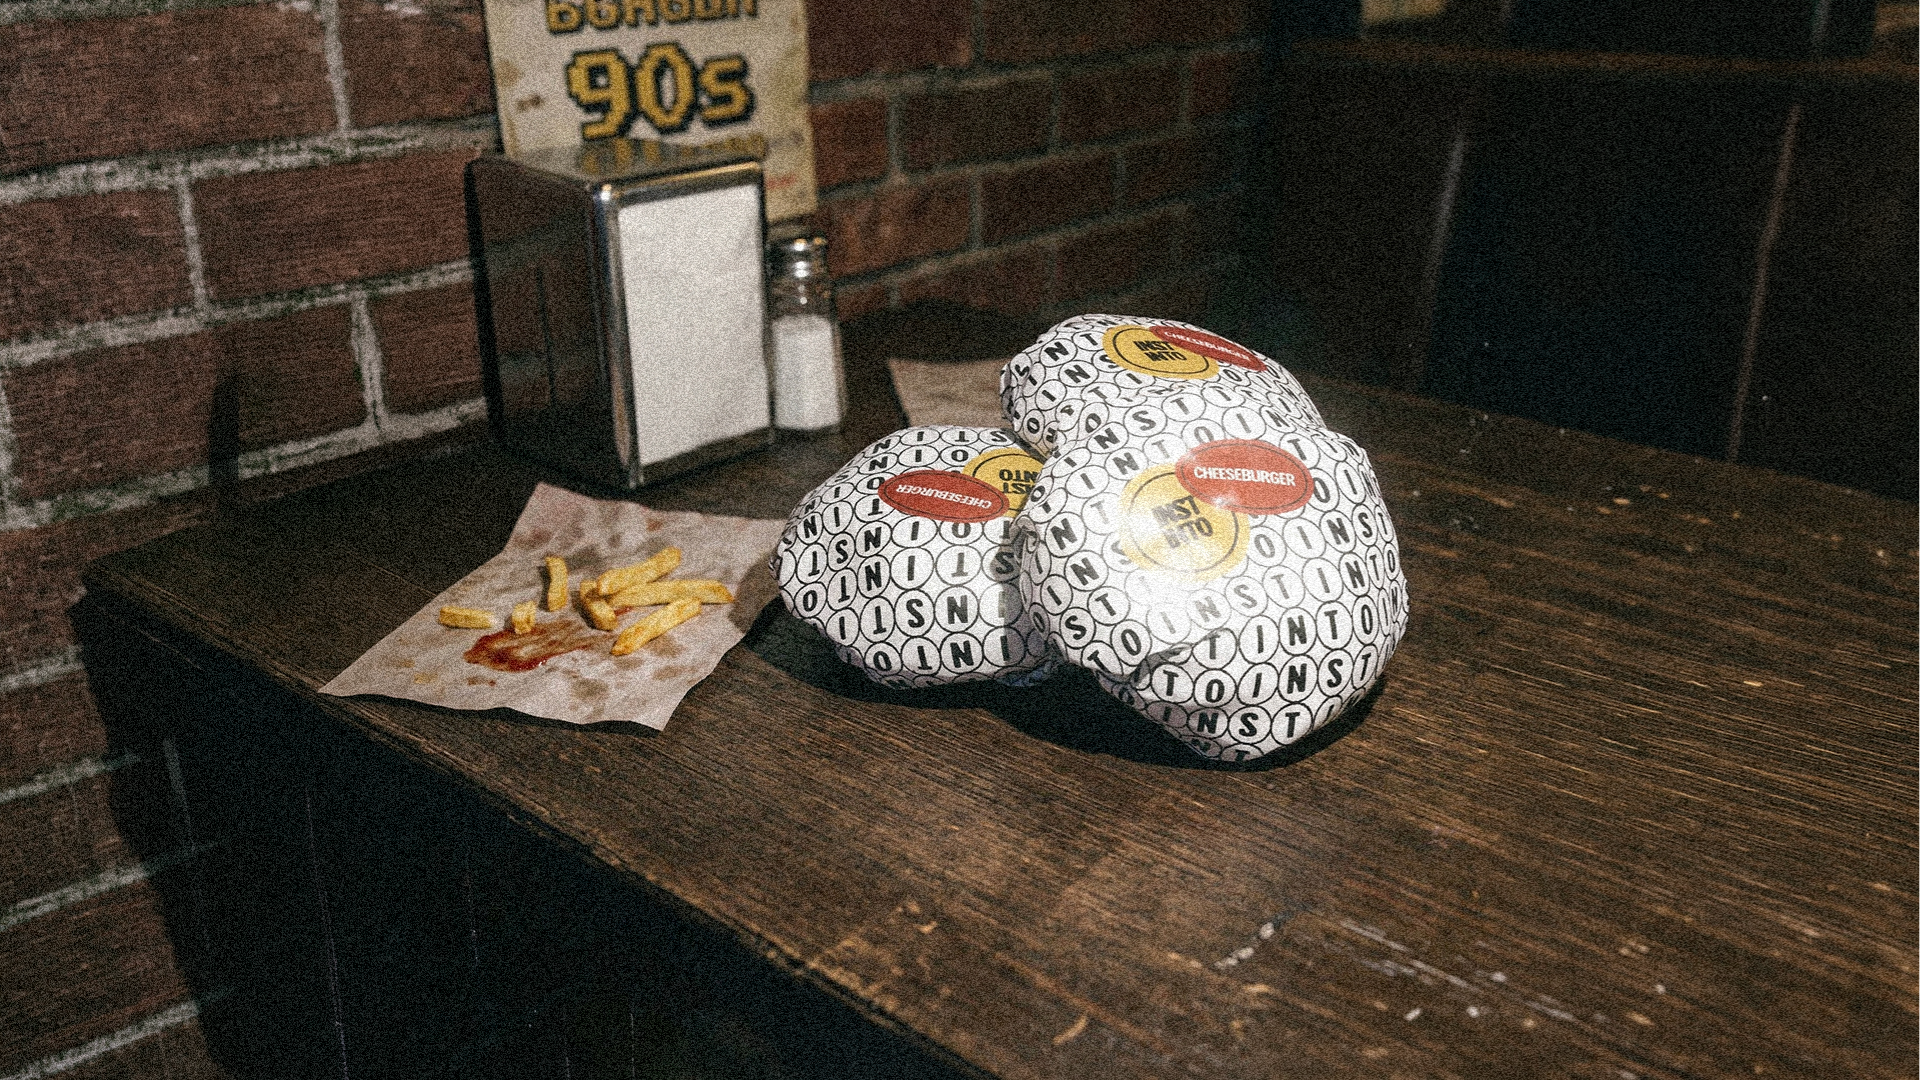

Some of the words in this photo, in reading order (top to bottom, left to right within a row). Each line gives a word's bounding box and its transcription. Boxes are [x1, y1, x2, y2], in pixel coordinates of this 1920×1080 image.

[566, 42, 753, 140] 90s
[1145, 351, 1188, 362] INTO
[1193, 466, 1296, 487] CHEESEBURGER
[896, 483, 992, 509] CHEESEBURGER
[1152, 495, 1200, 527] INST
[1163, 517, 1213, 549] INTO
